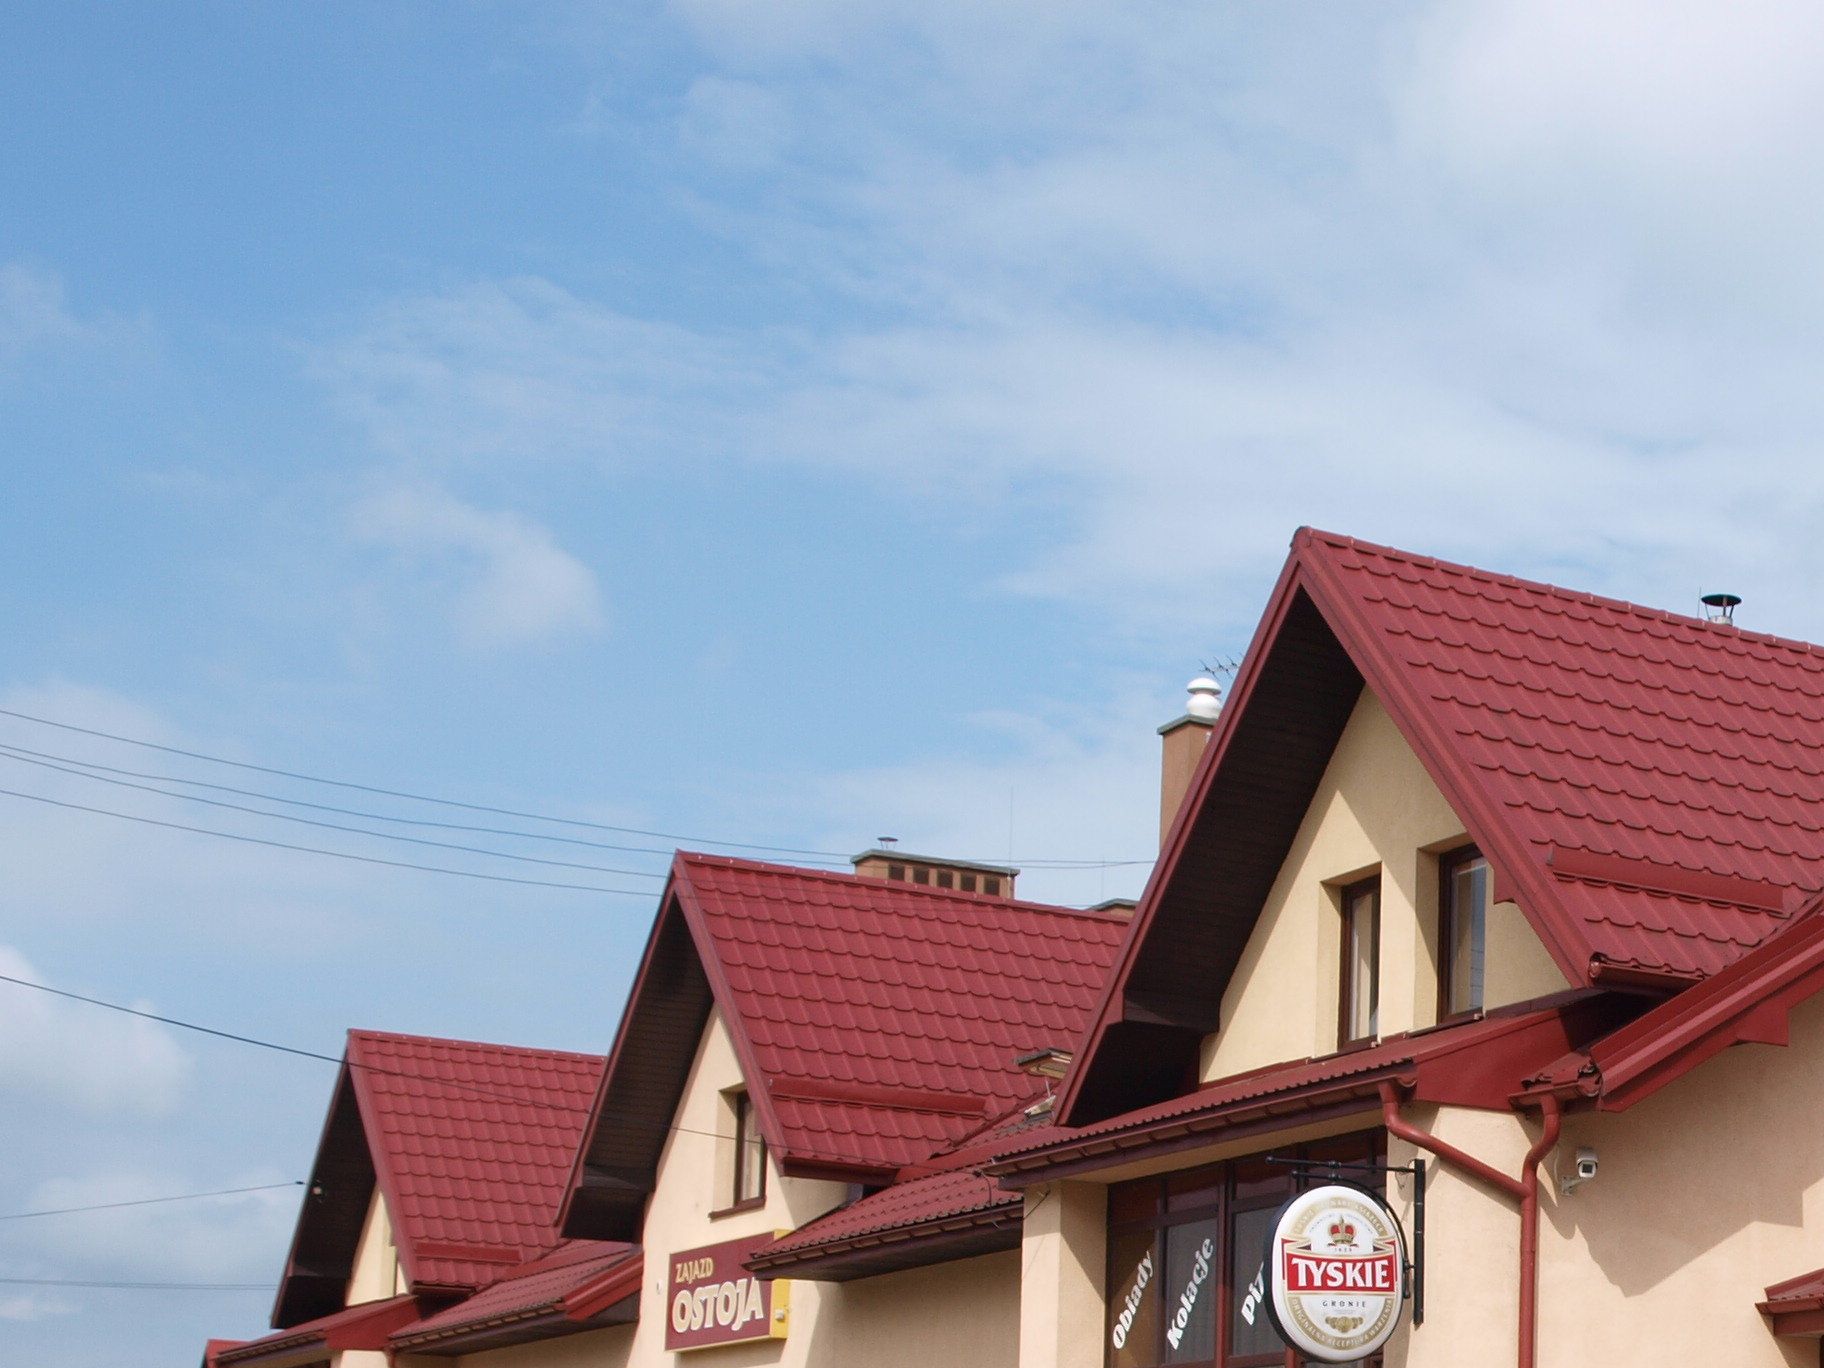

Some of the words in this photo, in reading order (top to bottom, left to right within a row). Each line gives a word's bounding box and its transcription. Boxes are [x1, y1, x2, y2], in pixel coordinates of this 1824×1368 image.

[675, 1257, 714, 1284] ZAJAZD
[1291, 1256, 1391, 1289] TYSKIE
[672, 1276, 765, 1334] OSTOJA
[1113, 1249, 1154, 1350] Obiady
[1167, 1238, 1214, 1350] Kolacje
[1322, 1300, 1366, 1308] GRONIE
